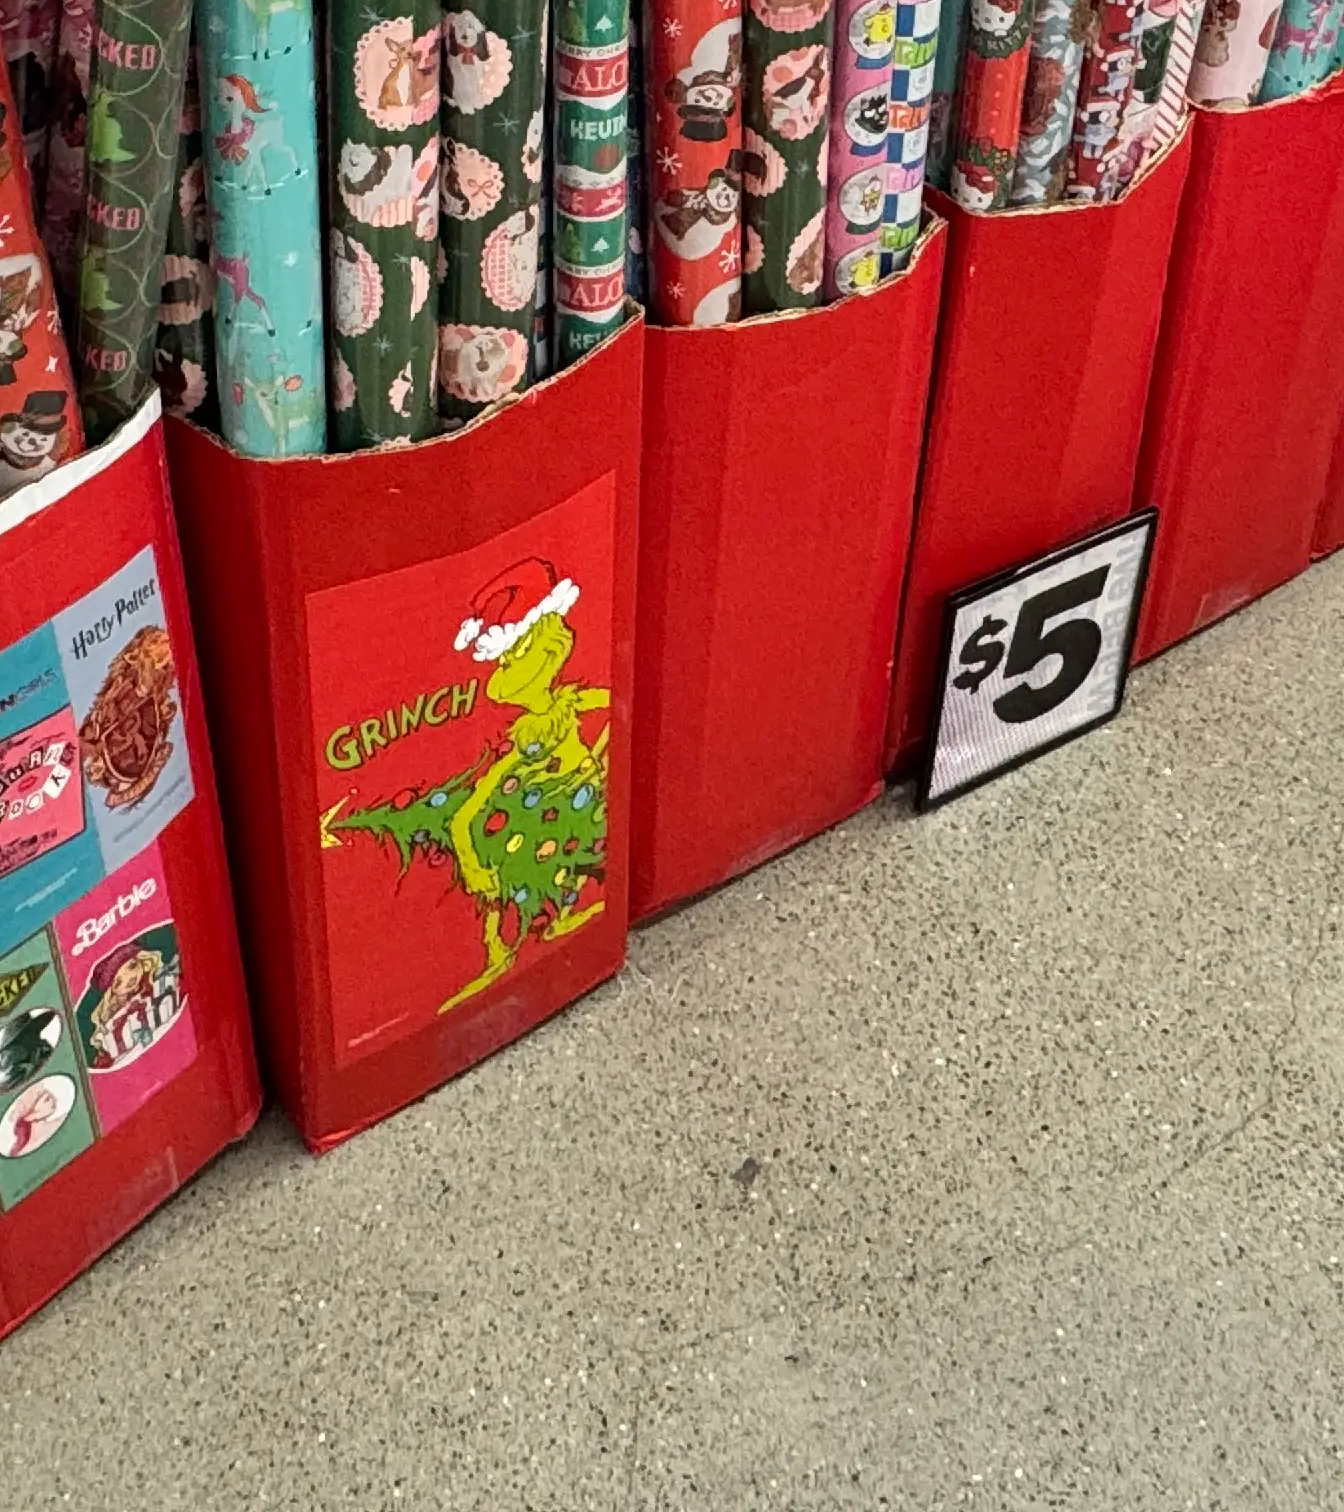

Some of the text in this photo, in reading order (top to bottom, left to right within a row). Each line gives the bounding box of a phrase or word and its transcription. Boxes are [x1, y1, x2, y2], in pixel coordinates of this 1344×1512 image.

[571, 57, 627, 93] ALO
[569, 272, 624, 306] ALO
[69, 578, 156, 661] Harry Potter
[952, 563, 1112, 724] $5
[324, 678, 479, 771] GRINCH
[70, 877, 158, 958] Barbie
